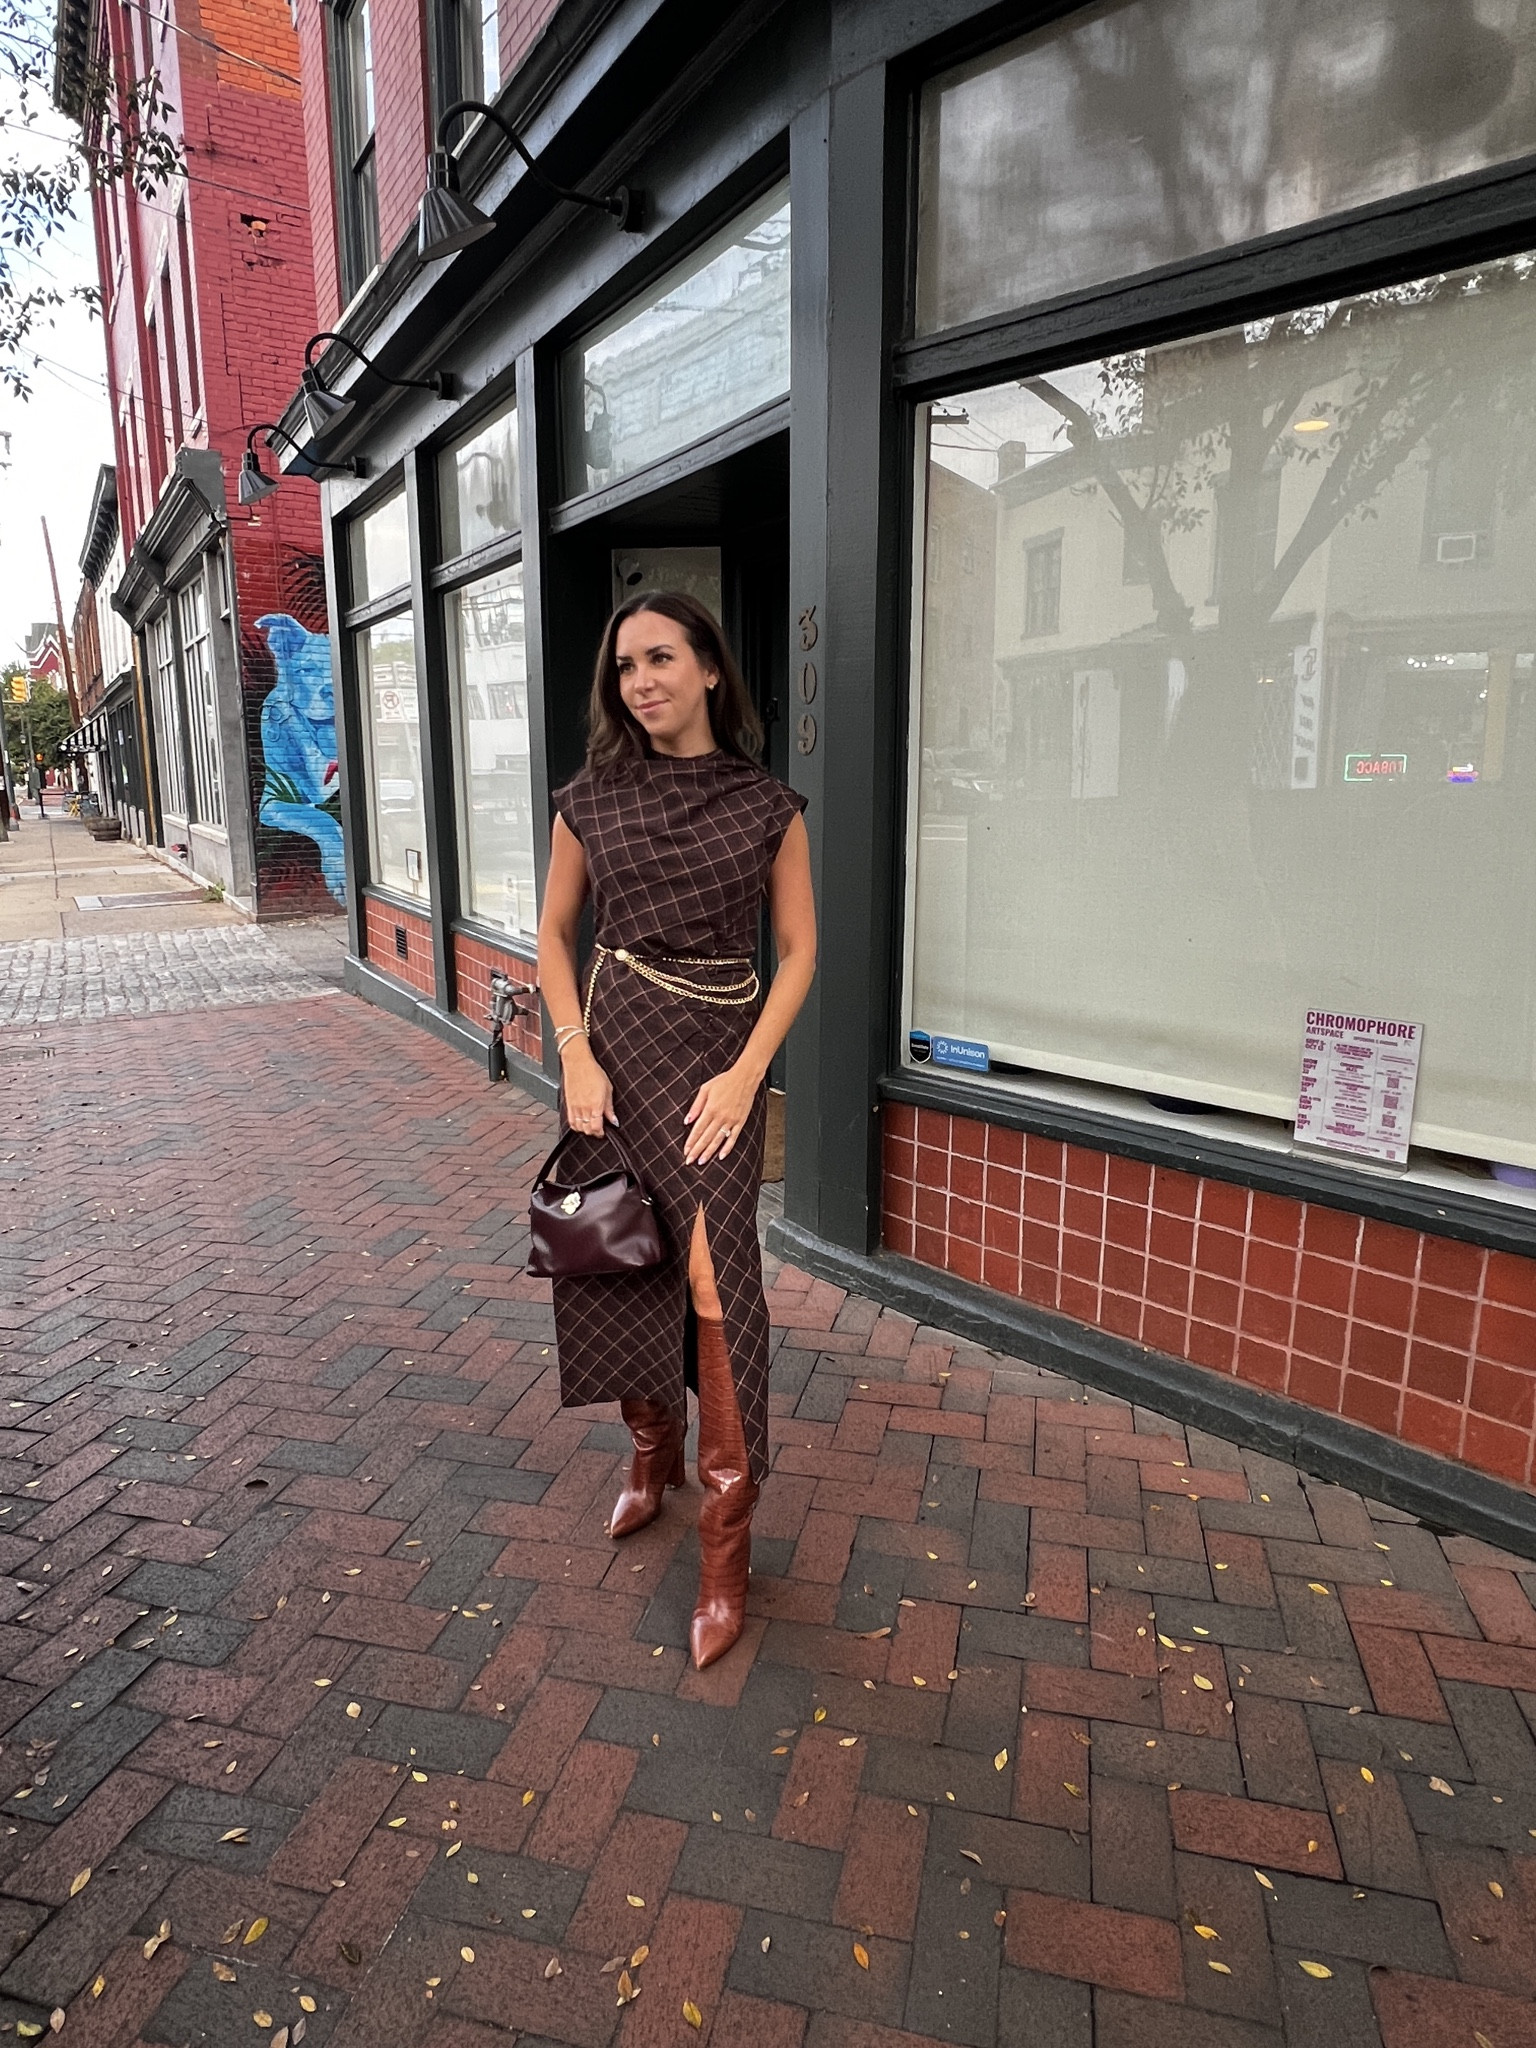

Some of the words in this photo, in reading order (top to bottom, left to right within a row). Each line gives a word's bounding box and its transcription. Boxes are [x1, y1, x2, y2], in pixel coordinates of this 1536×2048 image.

[798, 604, 818, 757] 309
[1305, 1026, 1345, 1039] ARTSPACE
[1306, 1011, 1417, 1040] CHROMOPHORE
[950, 1044, 985, 1059] InUnison
